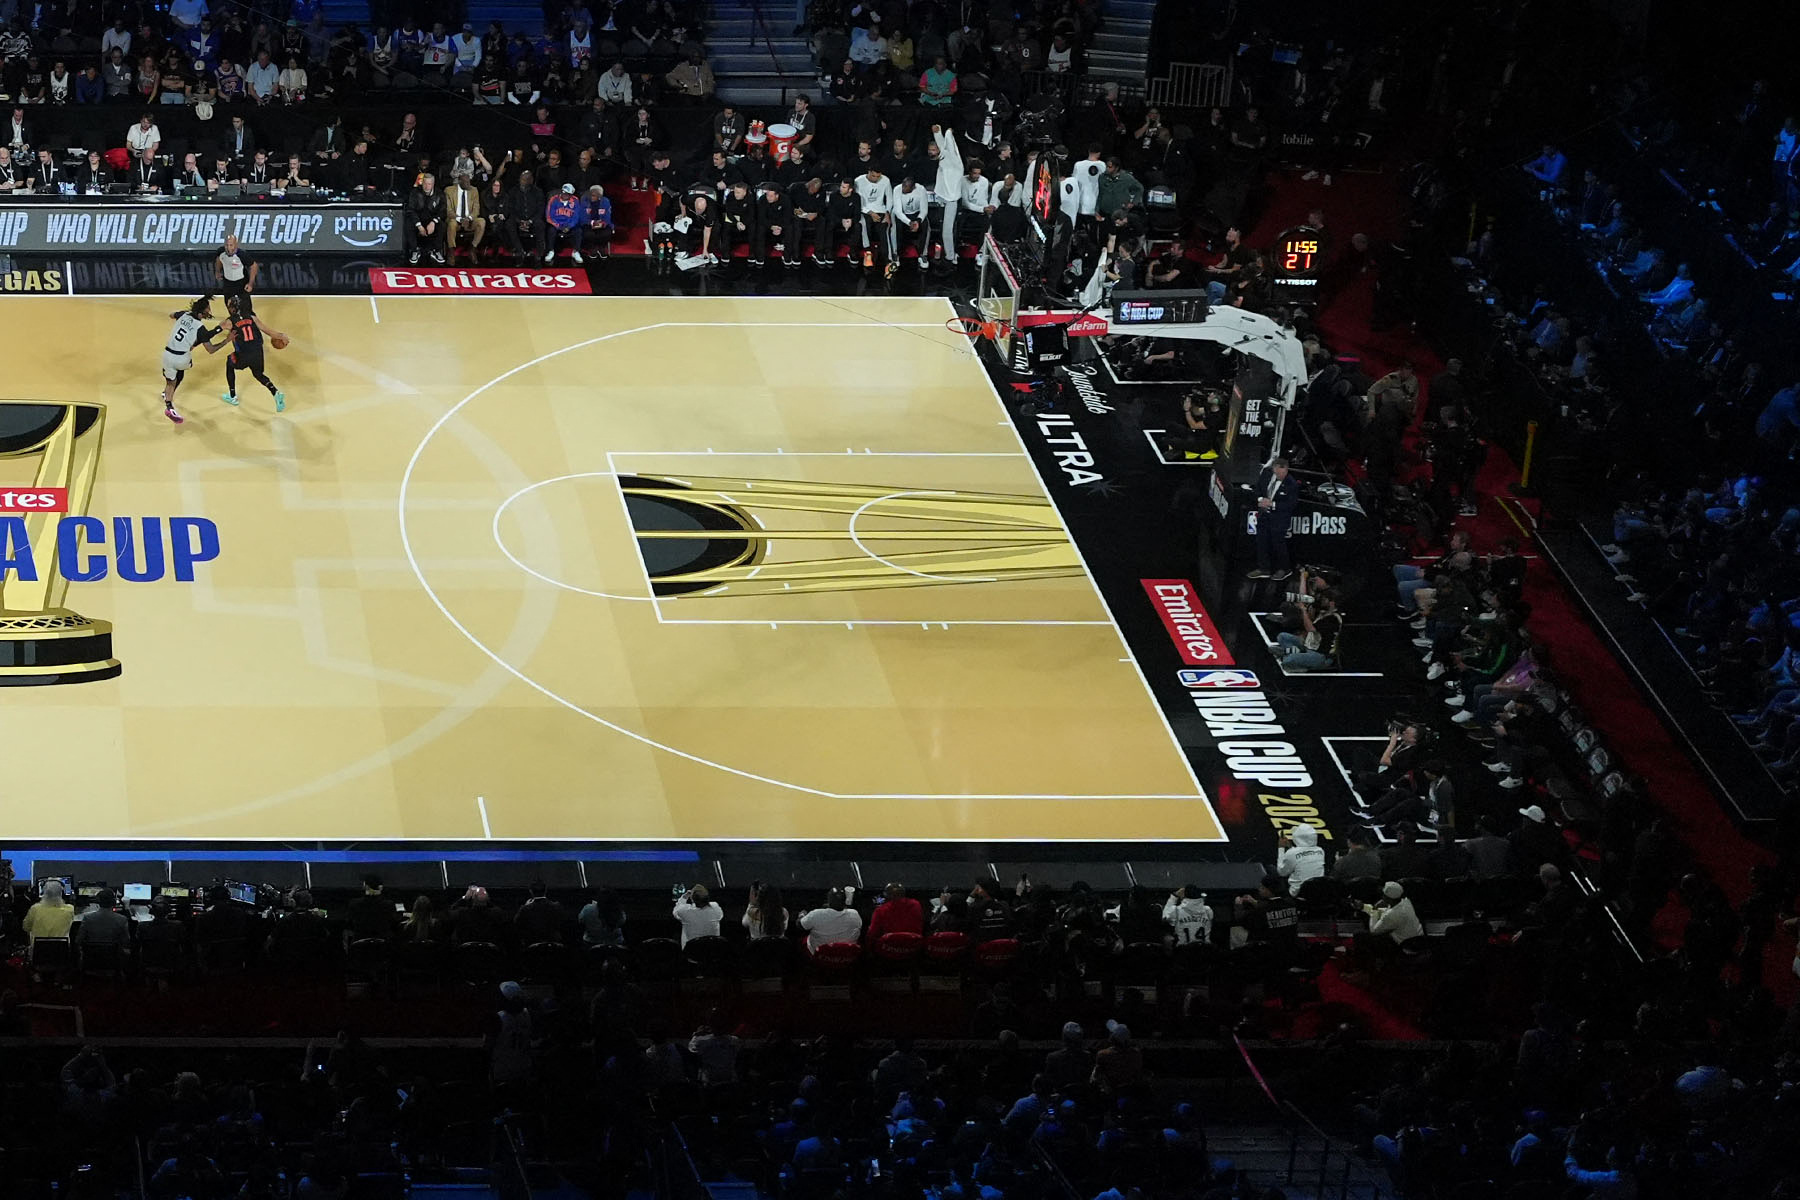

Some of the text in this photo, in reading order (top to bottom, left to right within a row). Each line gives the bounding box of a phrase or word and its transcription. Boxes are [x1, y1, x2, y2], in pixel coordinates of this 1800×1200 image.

[46, 213, 92, 244] WHO
[94, 213, 132, 244] WILL
[135, 213, 229, 244] CAPTURE
[234, 214, 271, 244] THE
[274, 214, 322, 244] CUP?
[334, 212, 393, 237] prime
[1287, 241, 1318, 253] 11:55
[1286, 253, 1311, 269] 21
[383, 271, 576, 288] Emirates
[1130, 306, 1164, 321] NBA CUP
[174, 328, 187, 342] 5
[242, 326, 254, 341] 11
[1246, 400, 1262, 411] GET
[1245, 411, 1260, 422] THE
[1246, 423, 1261, 437] App
[1312, 512, 1347, 535] Pass
[55, 515, 220, 582] CUP
[1154, 584, 1218, 661] Emirates
[1189, 691, 1286, 738] NBA
[1217, 741, 1314, 789] CUP
[1183, 926, 1206, 942] 14
